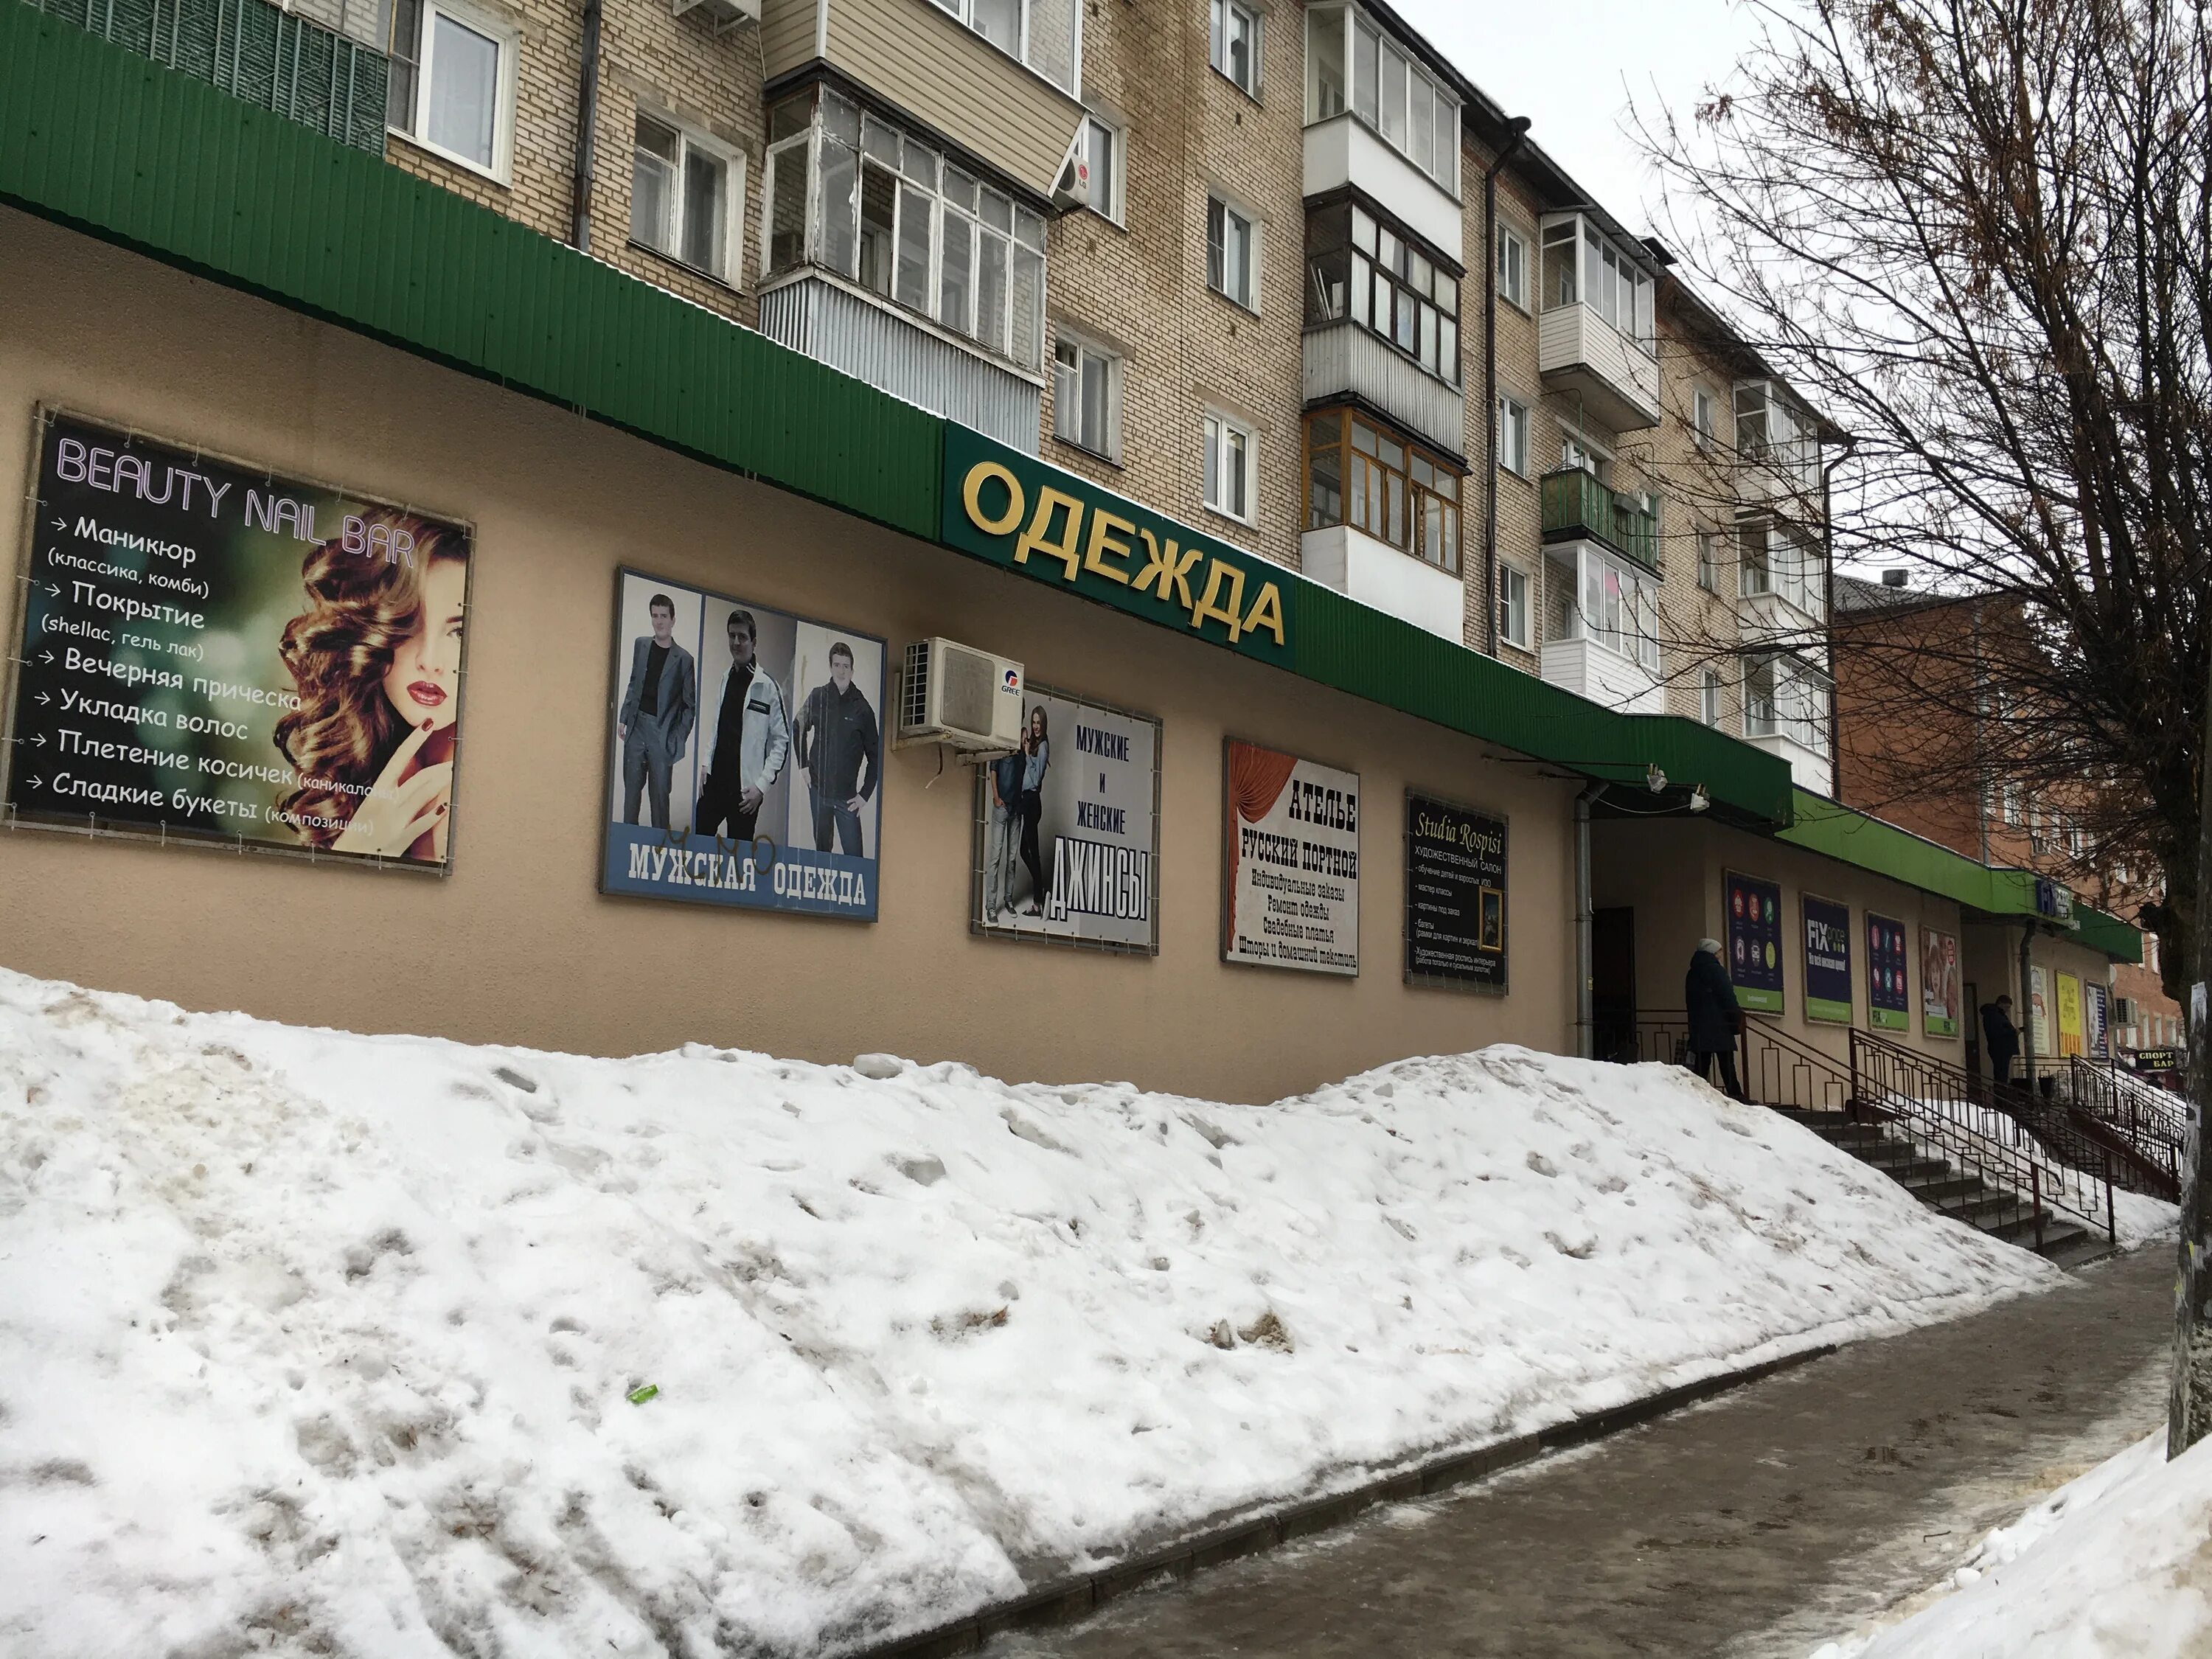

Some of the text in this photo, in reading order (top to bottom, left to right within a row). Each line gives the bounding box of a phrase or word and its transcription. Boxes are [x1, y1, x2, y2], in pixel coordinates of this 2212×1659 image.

[1079, 179, 1087, 189] LG
[57, 437, 415, 568] BEAUTY NAIL BAR
[74, 516, 197, 568] Маникюр
[963, 461, 1285, 647] ОДЕЖДА
[48, 546, 209, 599] (классика, комби)
[72, 580, 206, 629] Покрытие
[41, 613, 204, 662] (shellac, гель лак)
[65, 647, 302, 712] Вечерняя прическа
[1001, 685, 1021, 697] GREE
[59, 688, 248, 740] Укладка волос
[58, 728, 190, 771] Плетение
[198, 757, 293, 786] косичек
[1076, 724, 1130, 762] МУЖСКИЕ
[52, 772, 164, 807] Сладкие
[172, 787, 258, 818] букеты
[1077, 800, 1126, 835] ЖЕНСКИЕ
[1288, 779, 1356, 833] АТЕЛЬЕ
[1241, 827, 1357, 880] РУССКИЙ ПОРТНОЙ
[1415, 812, 1501, 860] Studia Rospisi
[628, 843, 867, 906] МУЖСКАЯ ОДЕЖДА
[1049, 835, 1149, 922] ДЖИНСЫ
[1414, 845, 1502, 875] ХУДОЖЕСТВЕННЫЙ САЛОН
[1418, 864, 1440, 877] обучение
[1458, 874, 1480, 886] взрослых
[1251, 868, 1345, 902] Индивидуальные заказы
[1267, 894, 1329, 920] Ремонт одежды
[1417, 902, 1438, 912] картины
[1438, 905, 1447, 915] под
[1418, 883, 1453, 897] мастер классы
[1239, 935, 1357, 968] Шторы и домашний текстиль
[1263, 917, 1335, 944] Свадебные платья
[2139, 1052, 2174, 1060] СПОРТ
